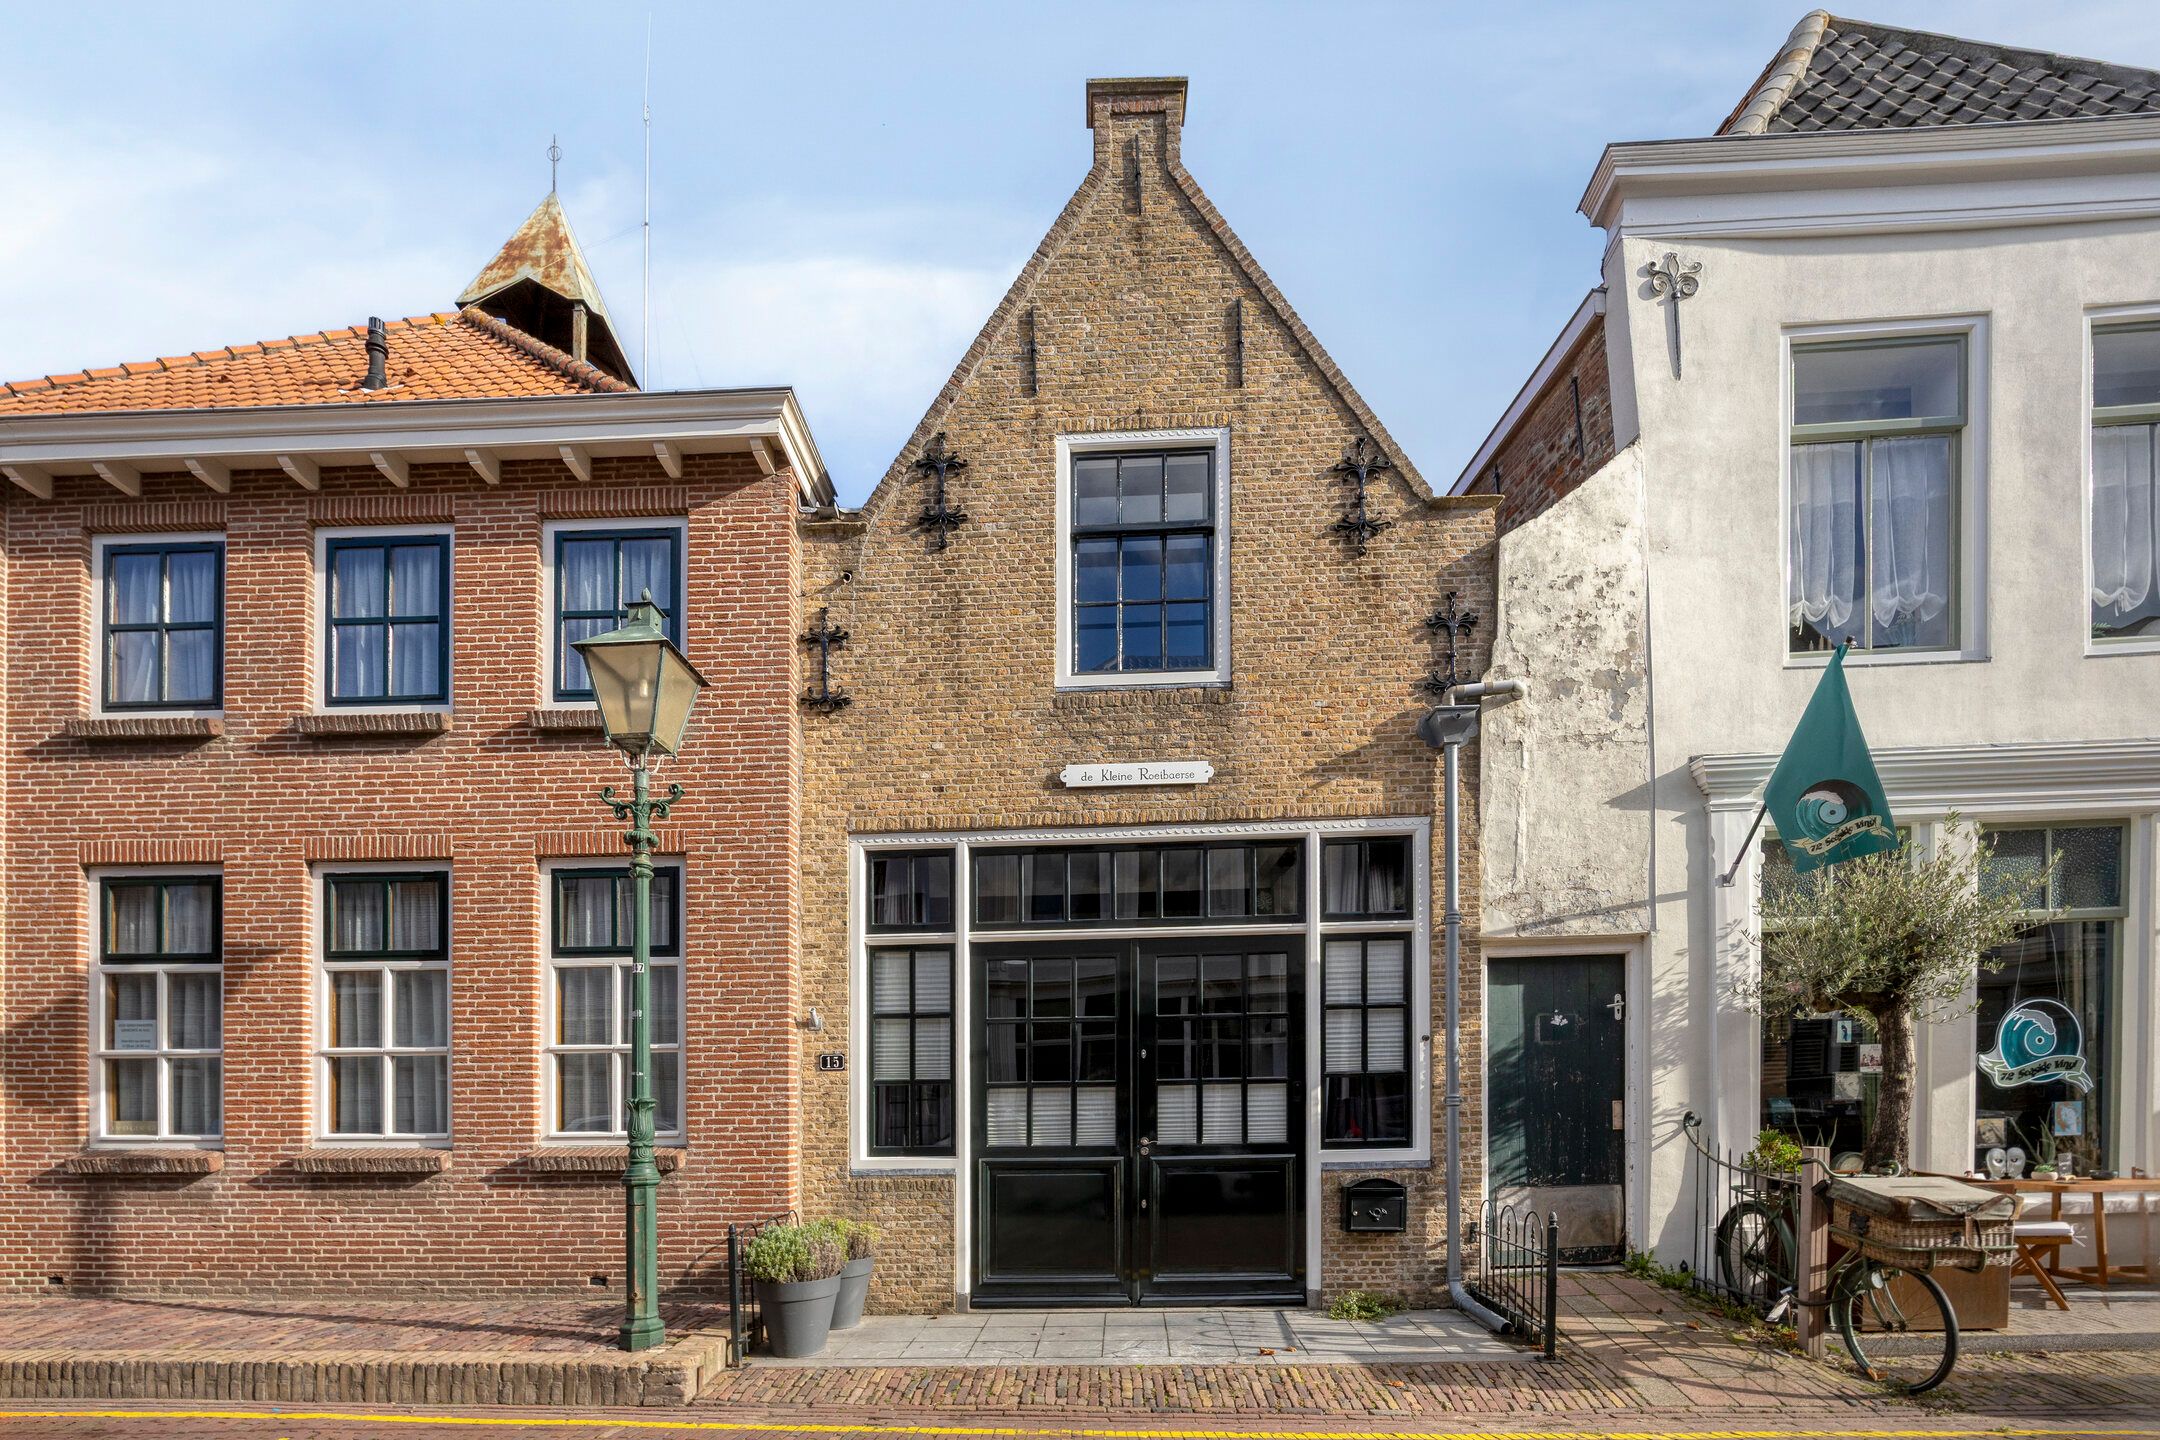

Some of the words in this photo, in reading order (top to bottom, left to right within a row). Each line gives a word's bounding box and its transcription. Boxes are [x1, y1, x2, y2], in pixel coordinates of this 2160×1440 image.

[1080, 771, 1093, 782] de
[1100, 768, 1133, 782] Kleine
[825, 1056, 840, 1068] 15
[2054, 1058, 2079, 1070] Vinyl
